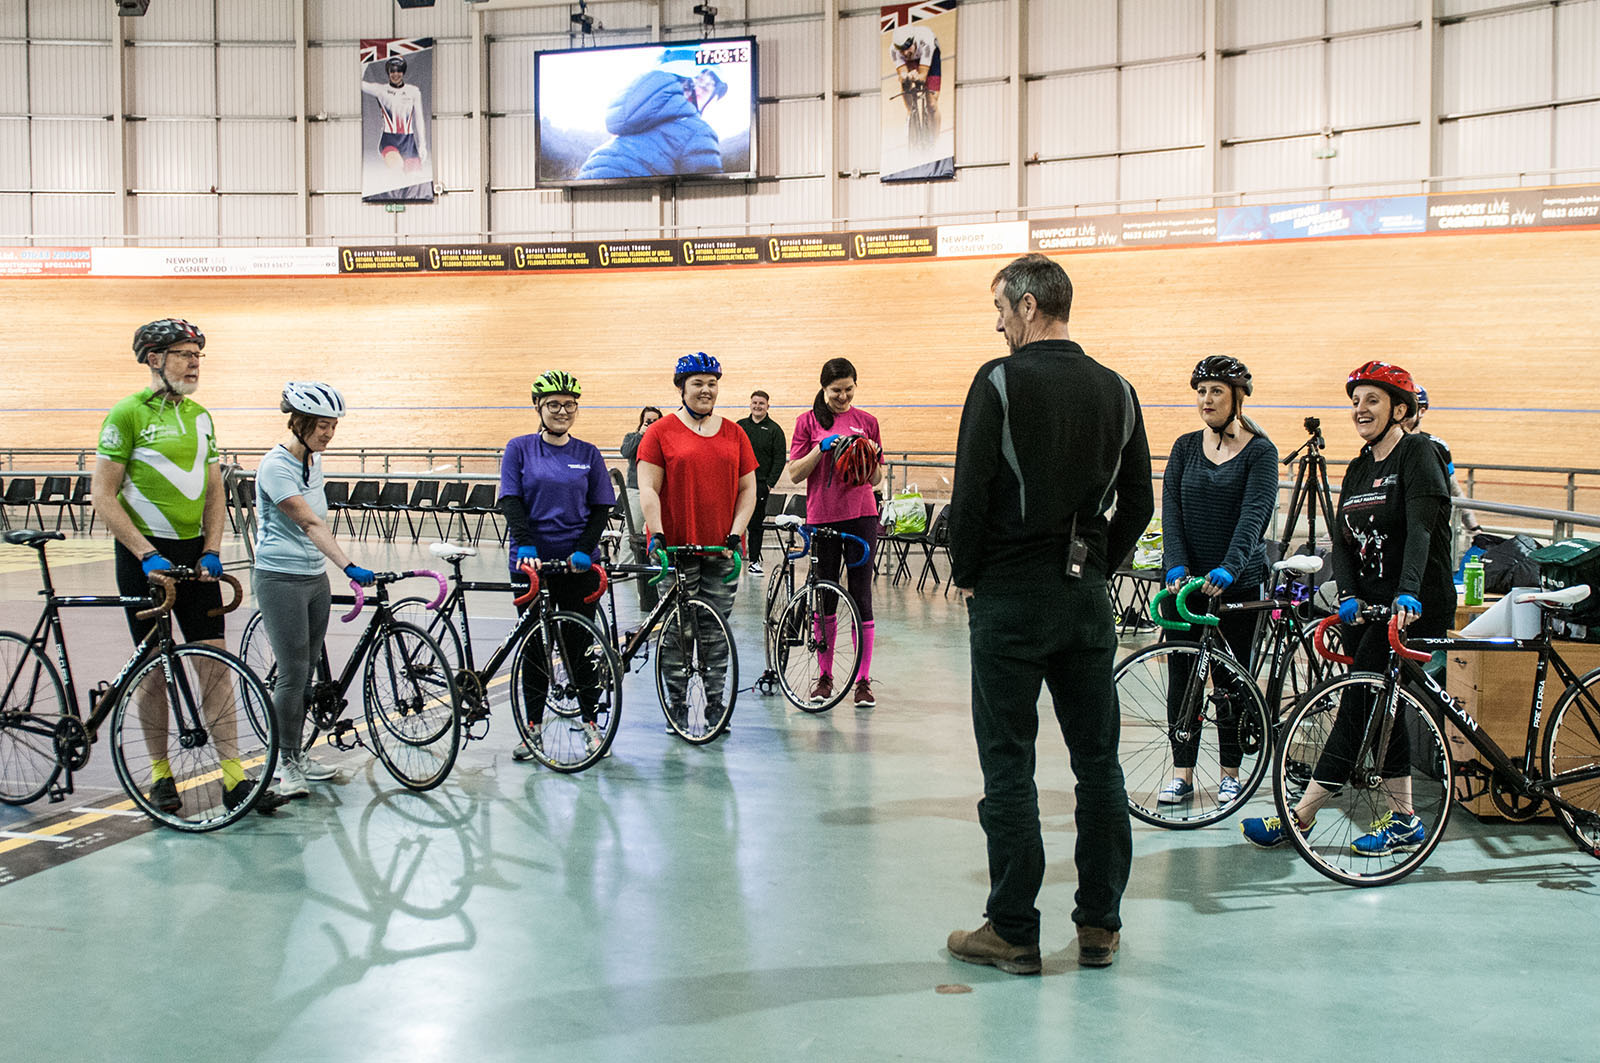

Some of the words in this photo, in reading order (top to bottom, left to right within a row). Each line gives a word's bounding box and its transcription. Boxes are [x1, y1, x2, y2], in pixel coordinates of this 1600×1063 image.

[695, 48, 748, 65] 17:03:13
[1430, 203, 1487, 217] NEWPORT
[1488, 196, 1510, 214] LIVE
[1031, 227, 1077, 239] NEWPORT
[1078, 221, 1096, 236] LIVE
[110, 640, 147, 688] DOLAN
[1199, 649, 1210, 681] ALPINA
[1390, 682, 1400, 719] ALPINA
[1424, 670, 1478, 732] DOLAN
[1536, 680, 1546, 710] CURSA
[1533, 710, 1542, 728] PRE
